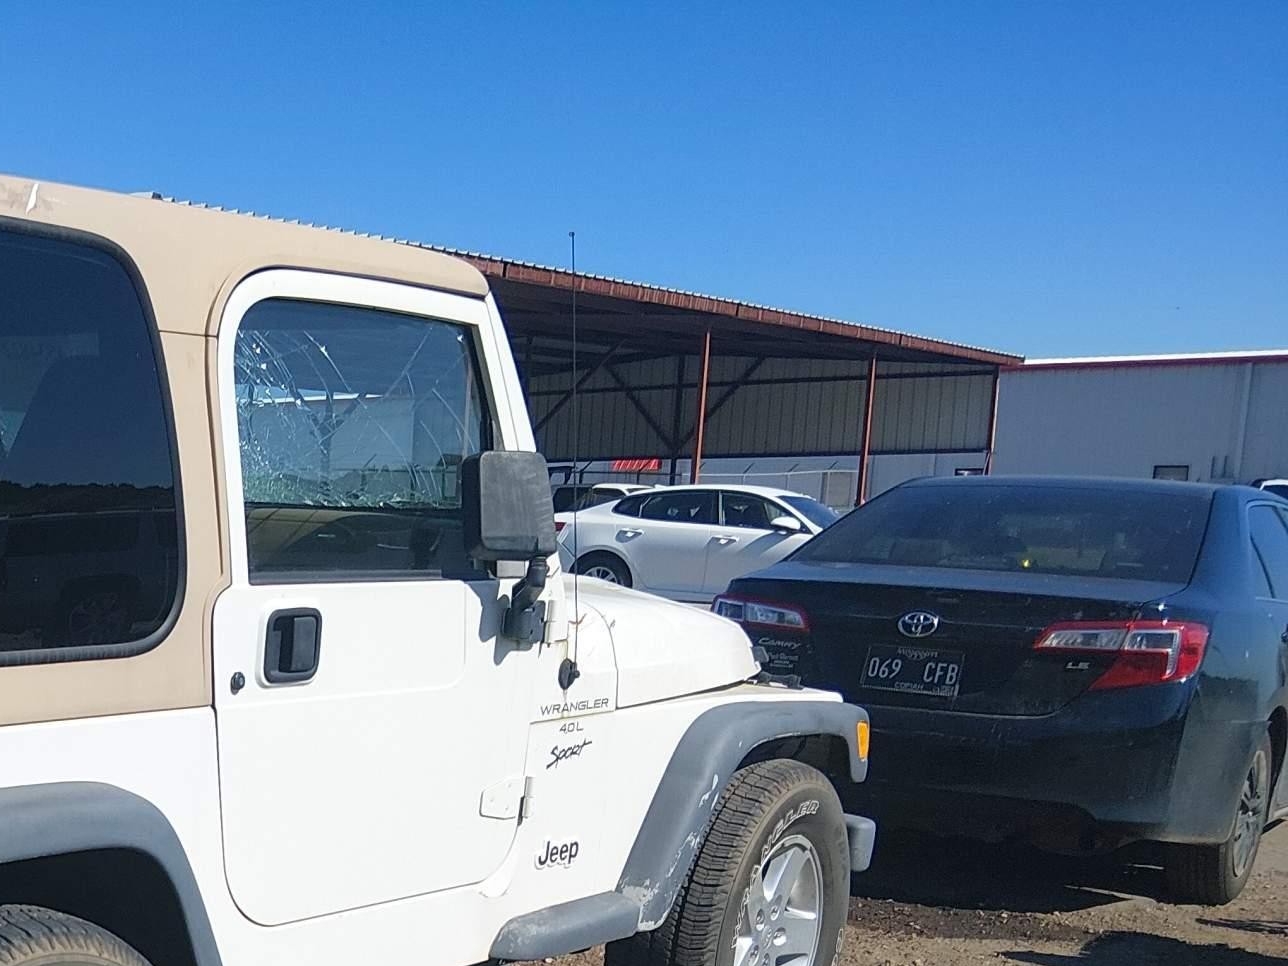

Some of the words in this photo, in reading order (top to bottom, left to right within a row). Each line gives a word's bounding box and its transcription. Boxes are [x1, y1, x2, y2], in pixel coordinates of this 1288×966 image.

[758, 637, 801, 650] Camry
[867, 656, 902, 679] 069
[922, 661, 959, 685] CFB
[1065, 661, 1091, 670] LE
[540, 697, 609, 716] WRANGLER
[538, 840, 579, 866] Jeep
